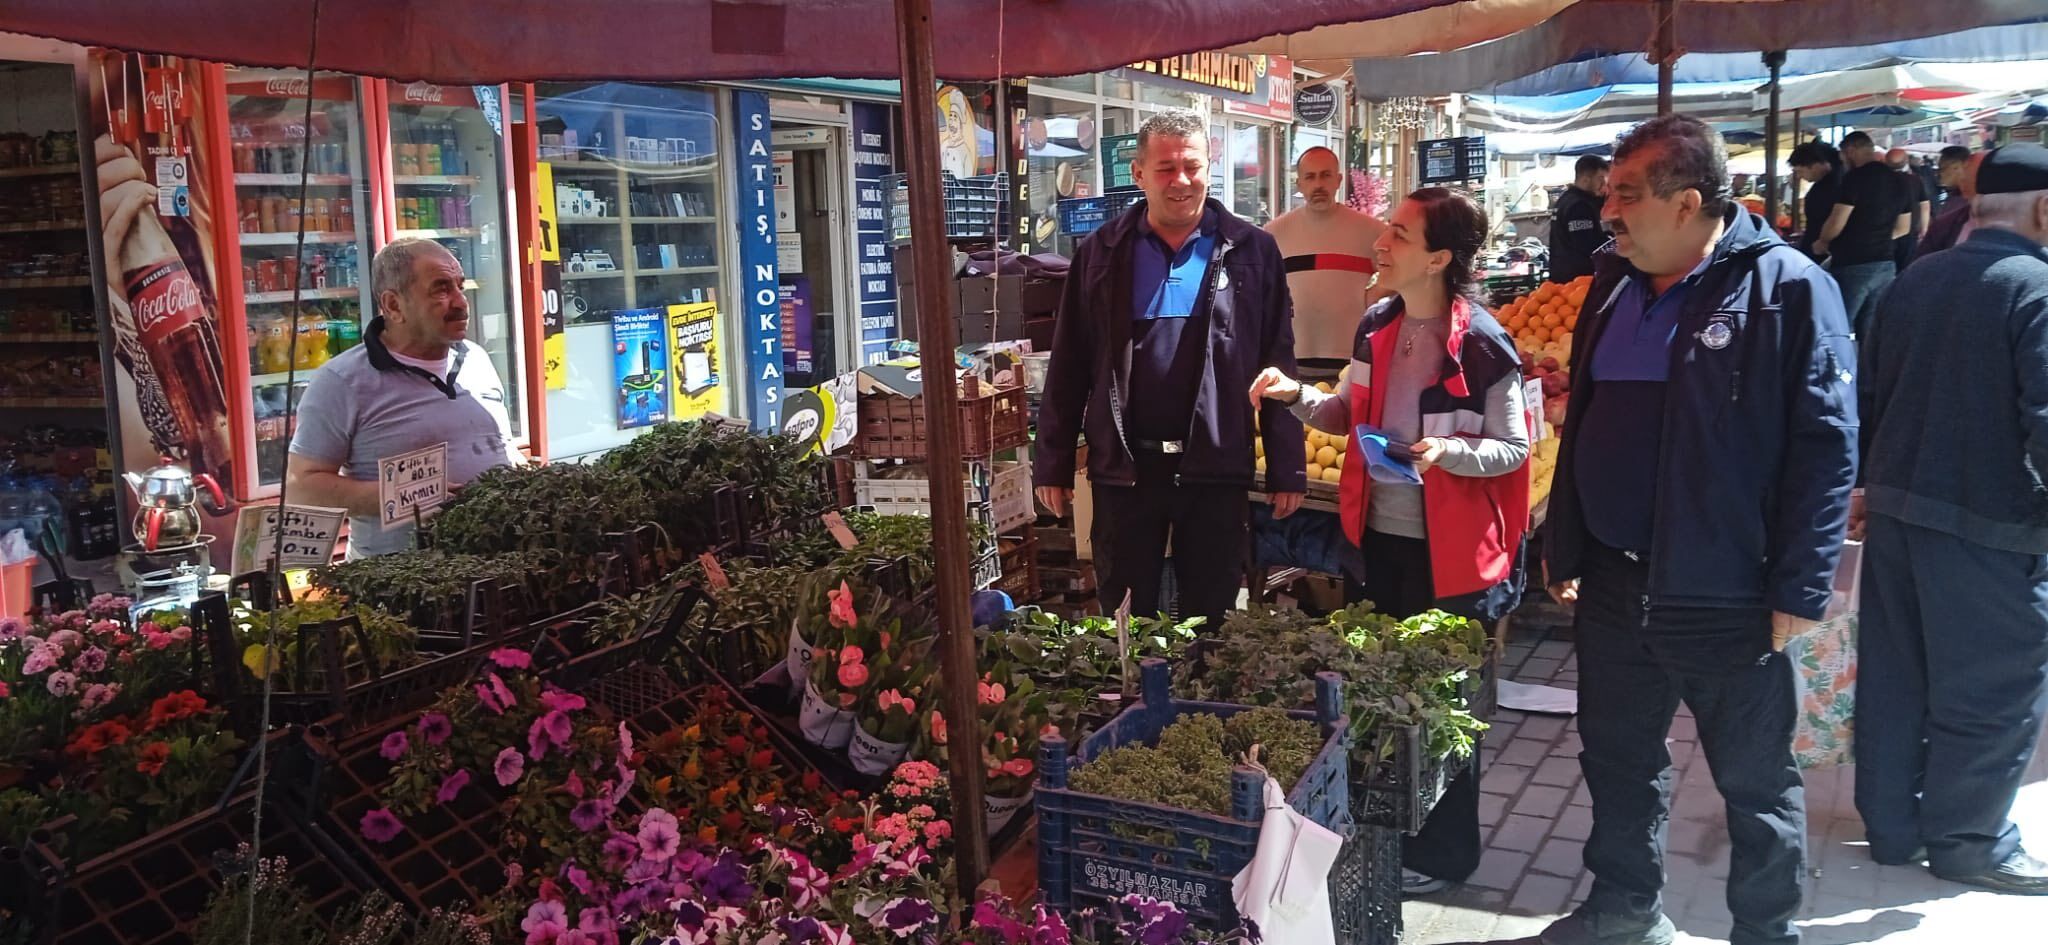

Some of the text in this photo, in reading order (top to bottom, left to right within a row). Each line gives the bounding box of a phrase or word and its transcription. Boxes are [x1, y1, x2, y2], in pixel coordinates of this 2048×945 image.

[1181, 52, 1256, 94] LAHMACUN
[138, 277, 200, 333] Coca-Cola
[754, 264, 779, 428] NOKTASI
